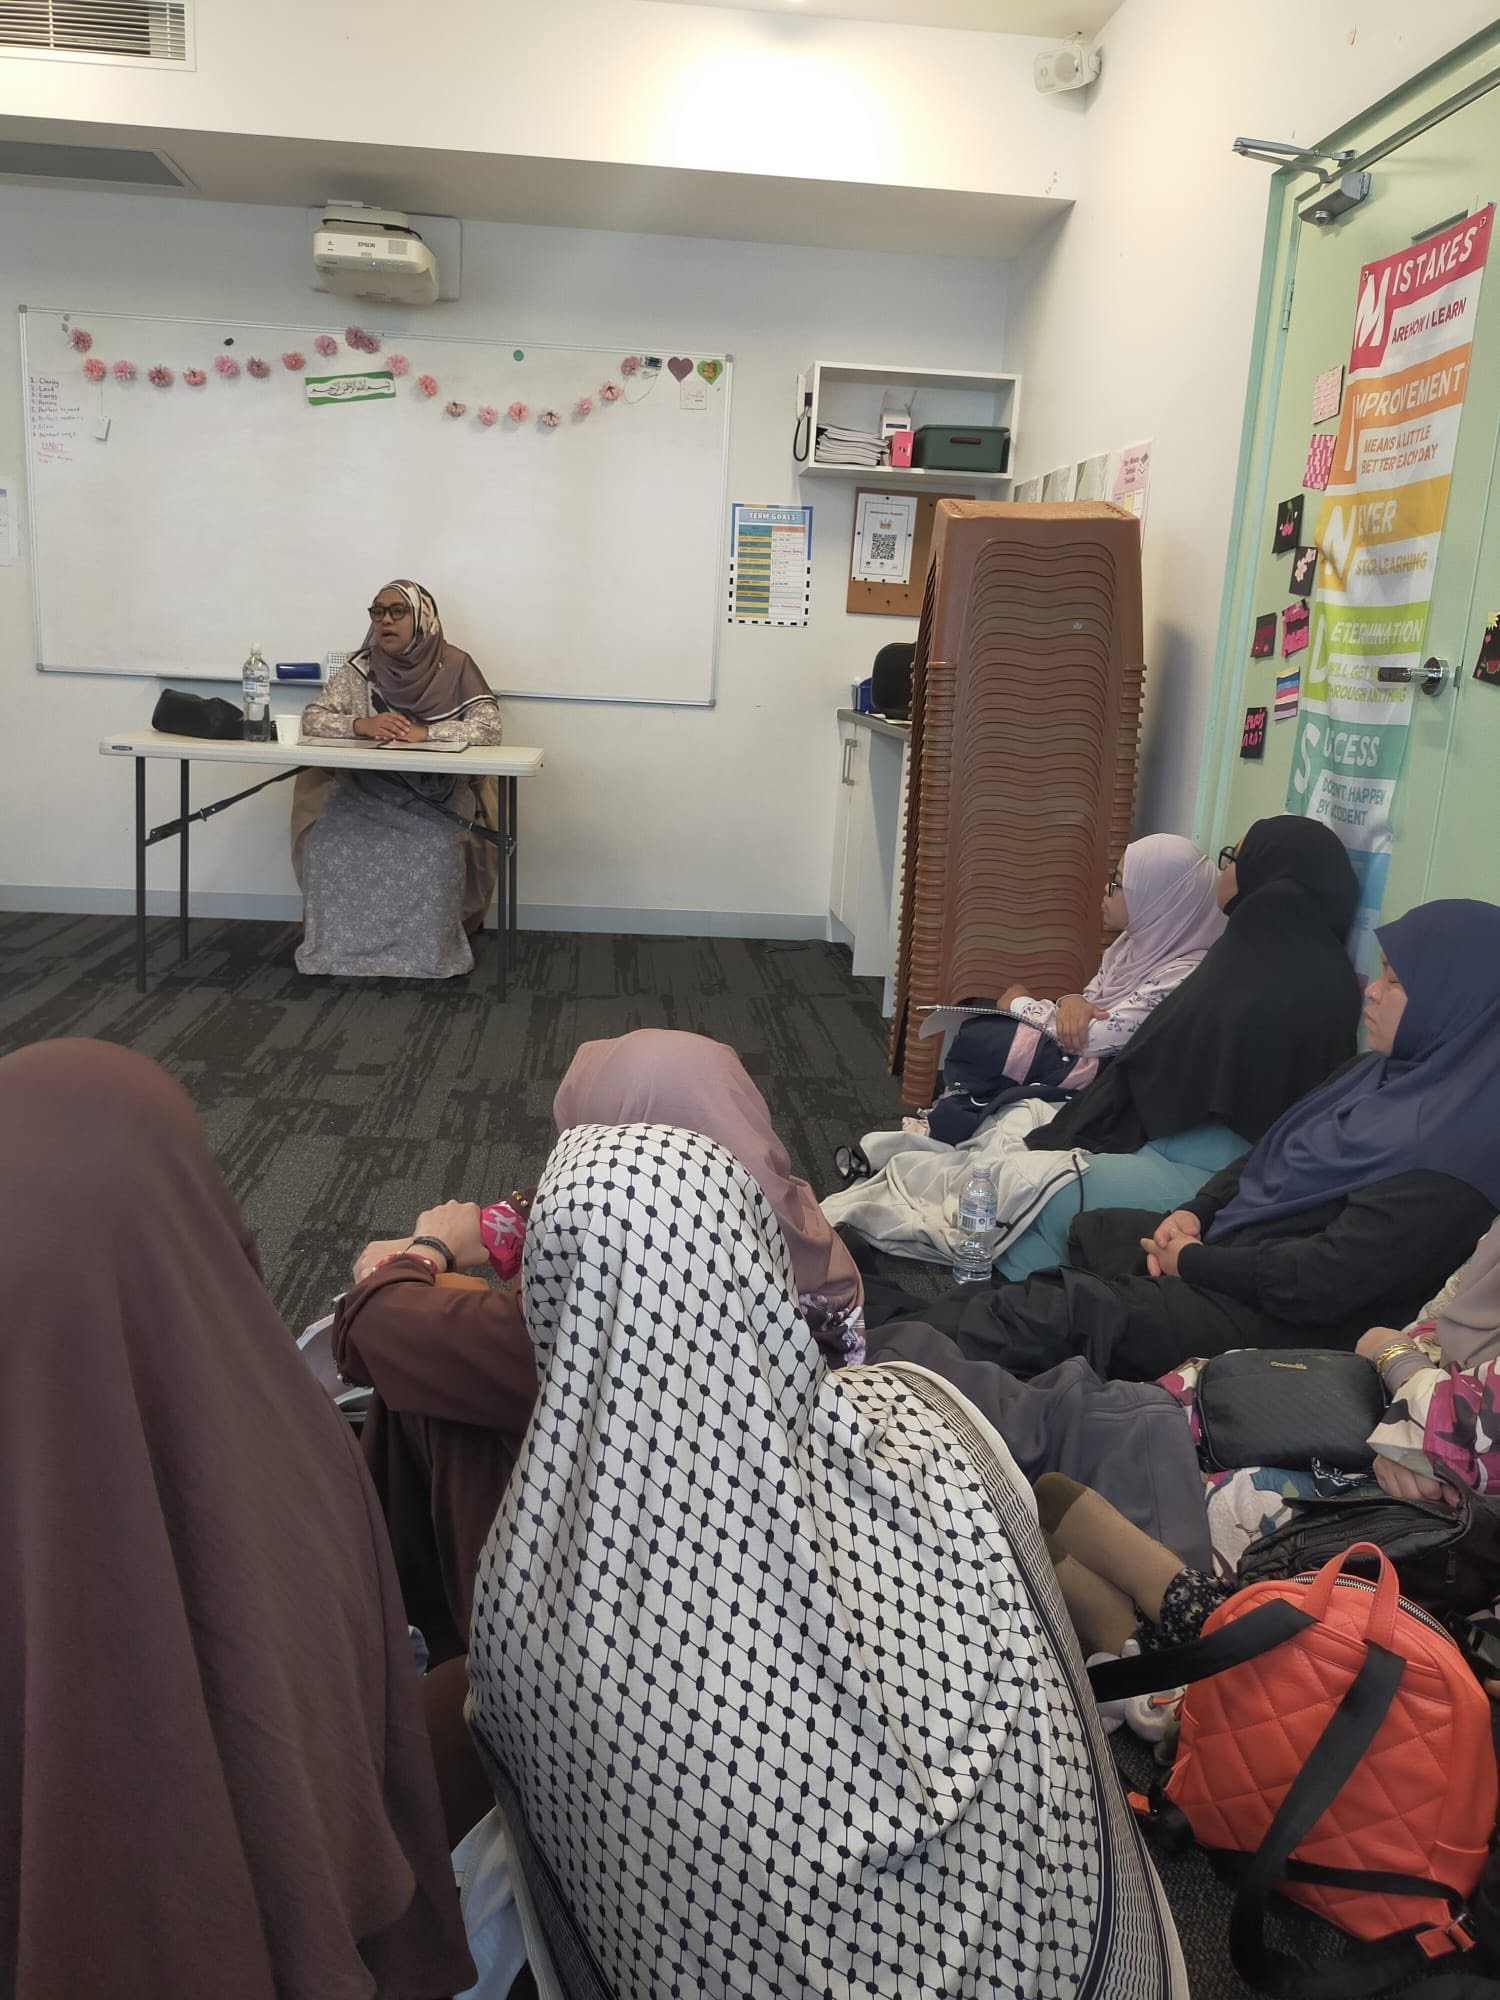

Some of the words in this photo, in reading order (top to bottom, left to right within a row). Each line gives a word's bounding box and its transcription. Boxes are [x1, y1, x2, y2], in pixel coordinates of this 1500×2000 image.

[1353, 226, 1478, 350] MISTAKES
[1391, 324, 1410, 345] ARE
[1432, 297, 1466, 328] LEARN
[1364, 436, 1396, 453] MEANS
[1402, 424, 1431, 448] LITTLE
[1361, 456, 1396, 474] BETTER
[1397, 450, 1418, 470] EACH
[1418, 443, 1439, 463] DAY
[750, 512, 769, 521] TERM
[771, 513, 796, 521] GOALS
[1378, 551, 1428, 576] LEARNING
[1316, 798, 1331, 815] BY
[1348, 786, 1386, 806] HAPPEN
